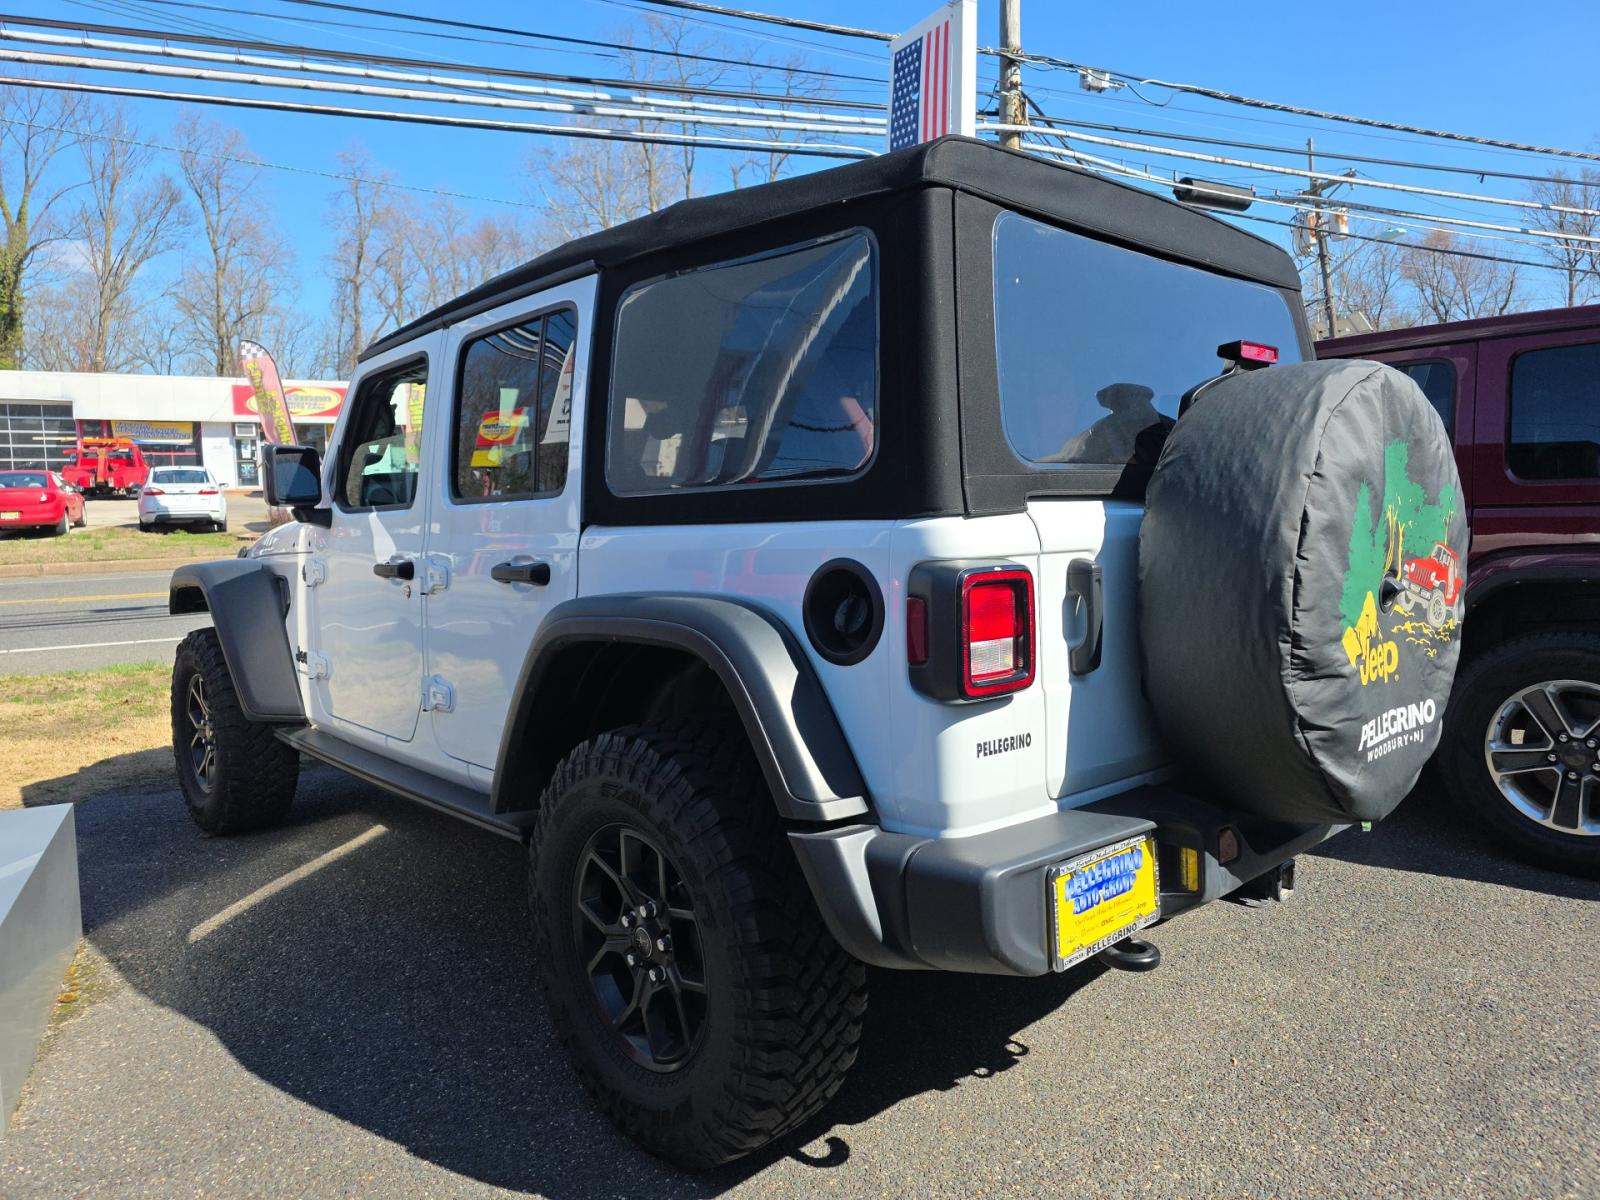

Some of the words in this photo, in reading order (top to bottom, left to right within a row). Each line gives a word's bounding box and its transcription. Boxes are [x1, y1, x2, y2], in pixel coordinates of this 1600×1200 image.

[1359, 636, 1399, 686] Jeep
[976, 732, 1032, 759] PELLEGRINO
[1358, 698, 1437, 752] PELLEGRINO
[1065, 849, 1143, 901] PELLEGRINO
[1073, 891, 1101, 914] AUTO
[1103, 874, 1138, 901] GROUP
[1086, 922, 1138, 956] PELLEGRINO
